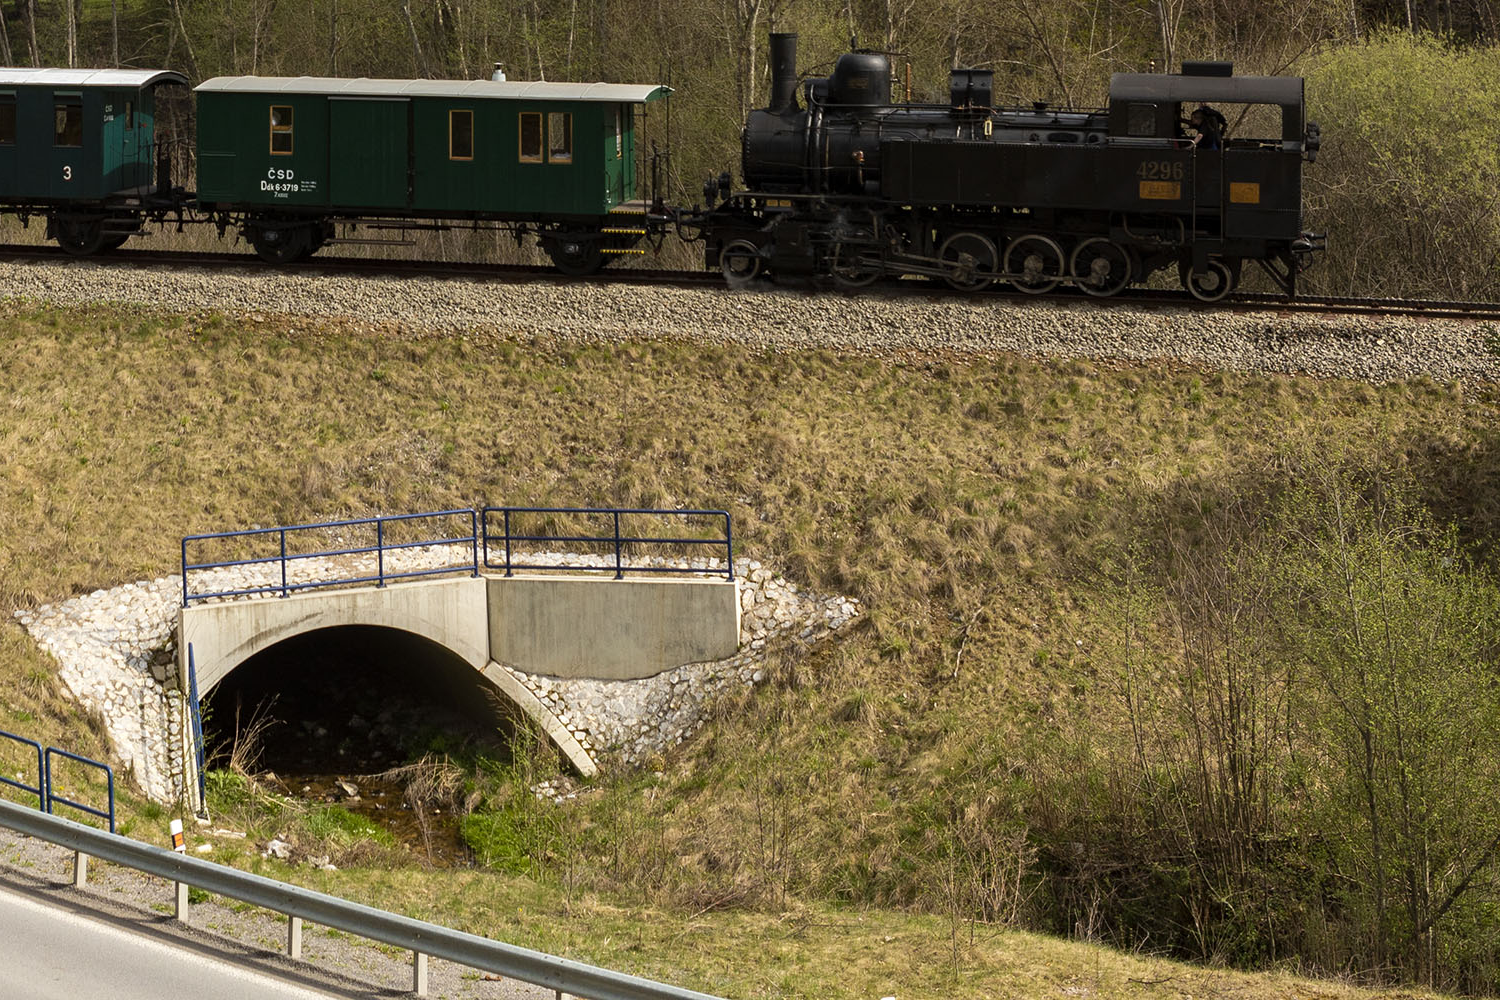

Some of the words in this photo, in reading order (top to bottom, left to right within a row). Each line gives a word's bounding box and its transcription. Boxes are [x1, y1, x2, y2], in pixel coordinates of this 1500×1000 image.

[62, 165, 72, 180] 3
[267, 167, 294, 180] ČSD
[1136, 160, 1184, 180] 4296
